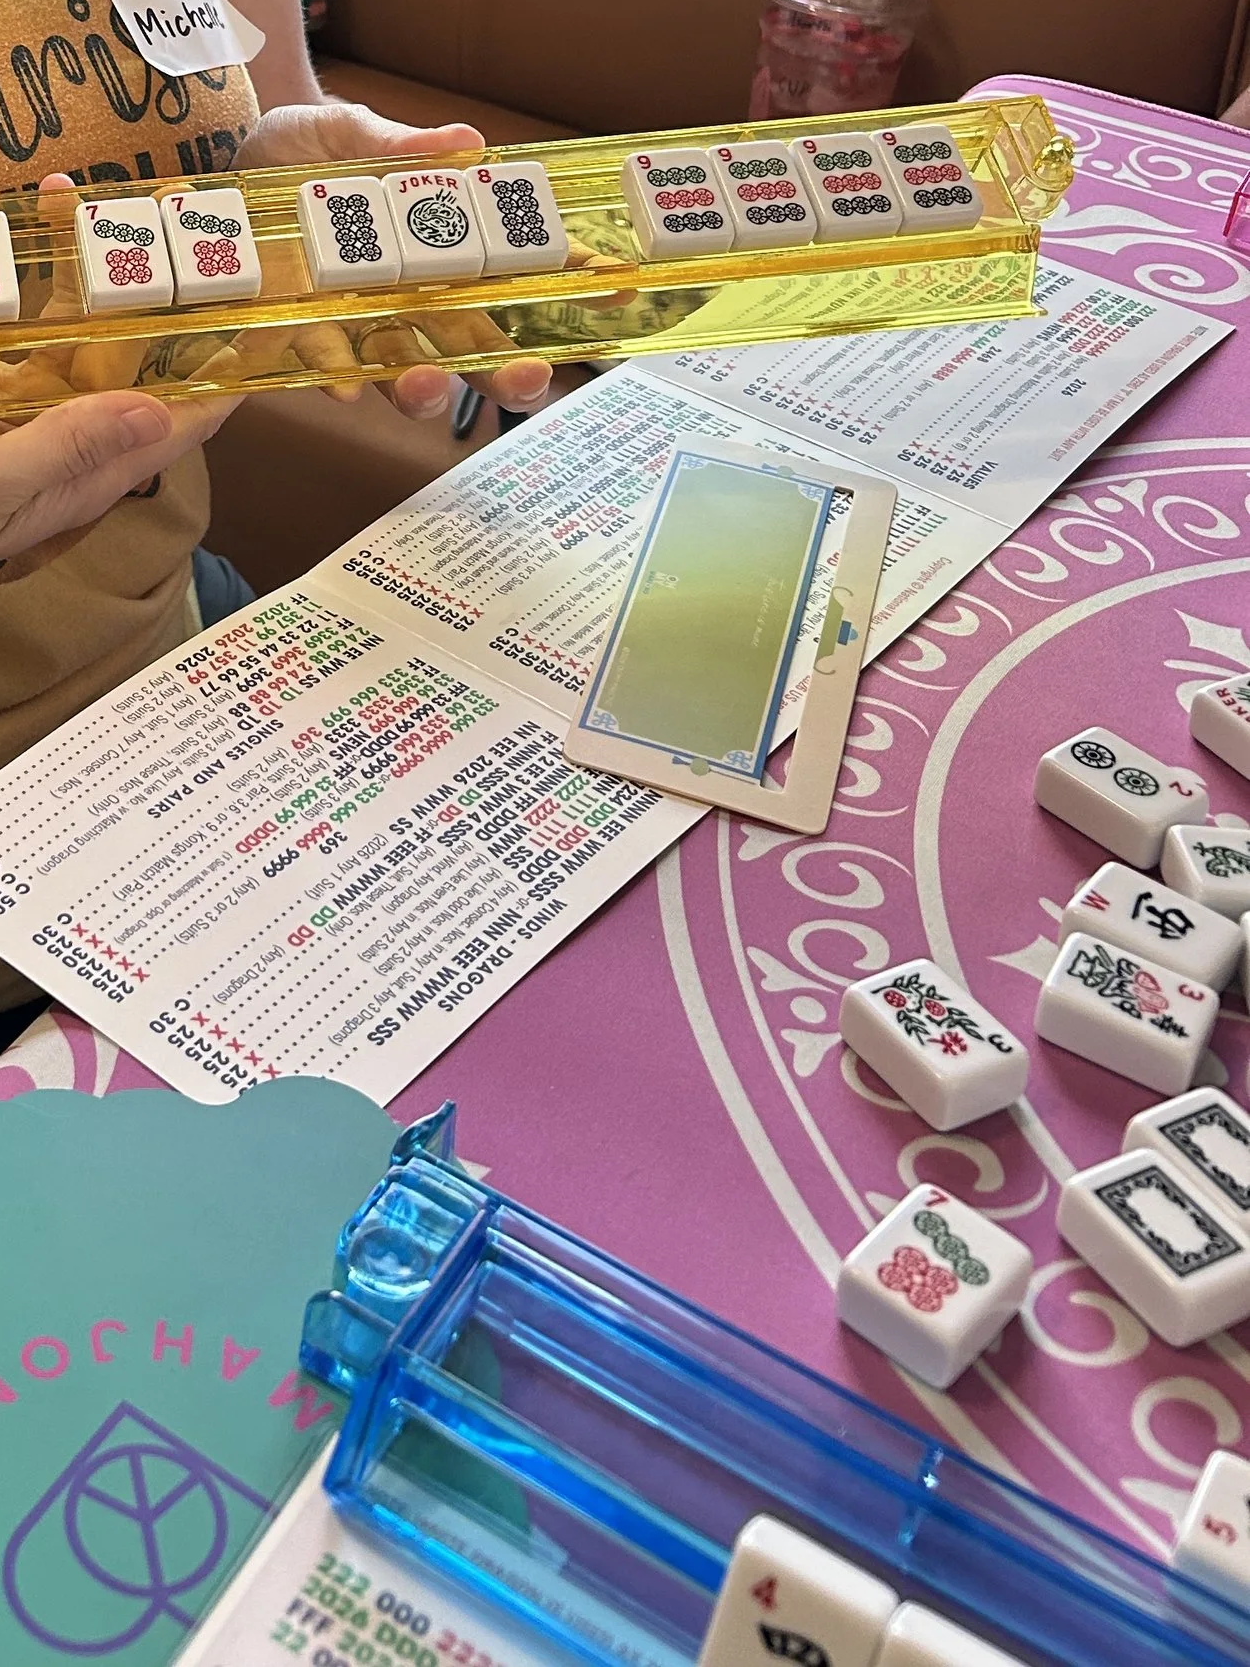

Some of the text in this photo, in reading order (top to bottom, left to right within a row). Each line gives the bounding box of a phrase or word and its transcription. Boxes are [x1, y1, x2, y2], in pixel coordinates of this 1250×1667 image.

[133, 1, 225, 46] Michelle
[803, 139, 817, 154] 9
[883, 132, 897, 147] 9
[637, 154, 651, 170] 9
[717, 147, 732, 163] 9
[398, 175, 459, 194] JOKER
[477, 168, 492, 185] 8
[313, 184, 327, 199] 8
[85, 204, 99, 221] 7
[170, 196, 184, 213] 7
[1136, 304, 1157, 317] 222
[1103, 325, 1130, 342] 2222
[976, 345, 1002, 363] 2468
[1084, 340, 1110, 357] 6666
[1060, 378, 1086, 396] 2026
[636, 427, 666, 445] 1111
[610, 444, 642, 462] 1111
[945, 468, 965, 483] 25
[956, 461, 973, 471] X
[962, 460, 998, 489] VALUES
[599, 512, 635, 537] 13579
[484, 530, 513, 550] Kongs
[461, 547, 490, 567] Match
[440, 564, 468, 581] Pair)
[916, 556, 952, 583] Copyright
[289, 592, 308, 605] FF
[425, 585, 442, 595] X
[884, 587, 918, 613] National
[410, 593, 431, 609] 25
[251, 601, 290, 627] 2026
[335, 617, 354, 630] FF
[214, 622, 254, 648] 2026
[303, 626, 339, 649] 3369
[174, 646, 215, 673] 2026
[270, 645, 306, 670] 3669
[147, 670, 174, 689] (Any
[235, 667, 272, 692] 3699
[140, 685, 153, 695] 3
[209, 688, 236, 706] (Any
[110, 691, 144, 714] Suits)
[202, 703, 215, 712] 3
[1215, 687, 1250, 722] KER
[173, 709, 207, 731] Suits)
[146, 718, 283, 818] SINGLES AND PAIRS
[1169, 780, 1193, 797] 2
[31, 656, 426, 945] FF 333 666 999 369 (Any 2 Suits) C 30
[618, 789, 663, 823] NNNN
[61, 672, 455, 968] 33 66 666 999 NEWS (Any 2 Suits) X 30
[595, 819, 626, 841] EEE
[91, 689, 485, 991] 33 66 333 666 9999 (Any 3 Suits) X 25
[318, 830, 348, 854] 369
[559, 838, 604, 875] WWW
[148, 720, 541, 1033] NN EEE 2026 WWW SS (2026 Any 1 Suit) C 30
[1080, 889, 1111, 912] W
[516, 898, 567, 939] WINDS
[451, 936, 490, 969] EEEE
[437, 945, 512, 1011] DRAGONS
[396, 966, 459, 1021] WWWW
[1178, 984, 1205, 1001] 3
[366, 1016, 401, 1046] SSS
[988, 1034, 1013, 1053] 3
[924, 1190, 948, 1208] 7
[1204, 1514, 1238, 1546] 5
[316, 1551, 431, 1636] 222 000
[751, 1575, 778, 1613] 4
